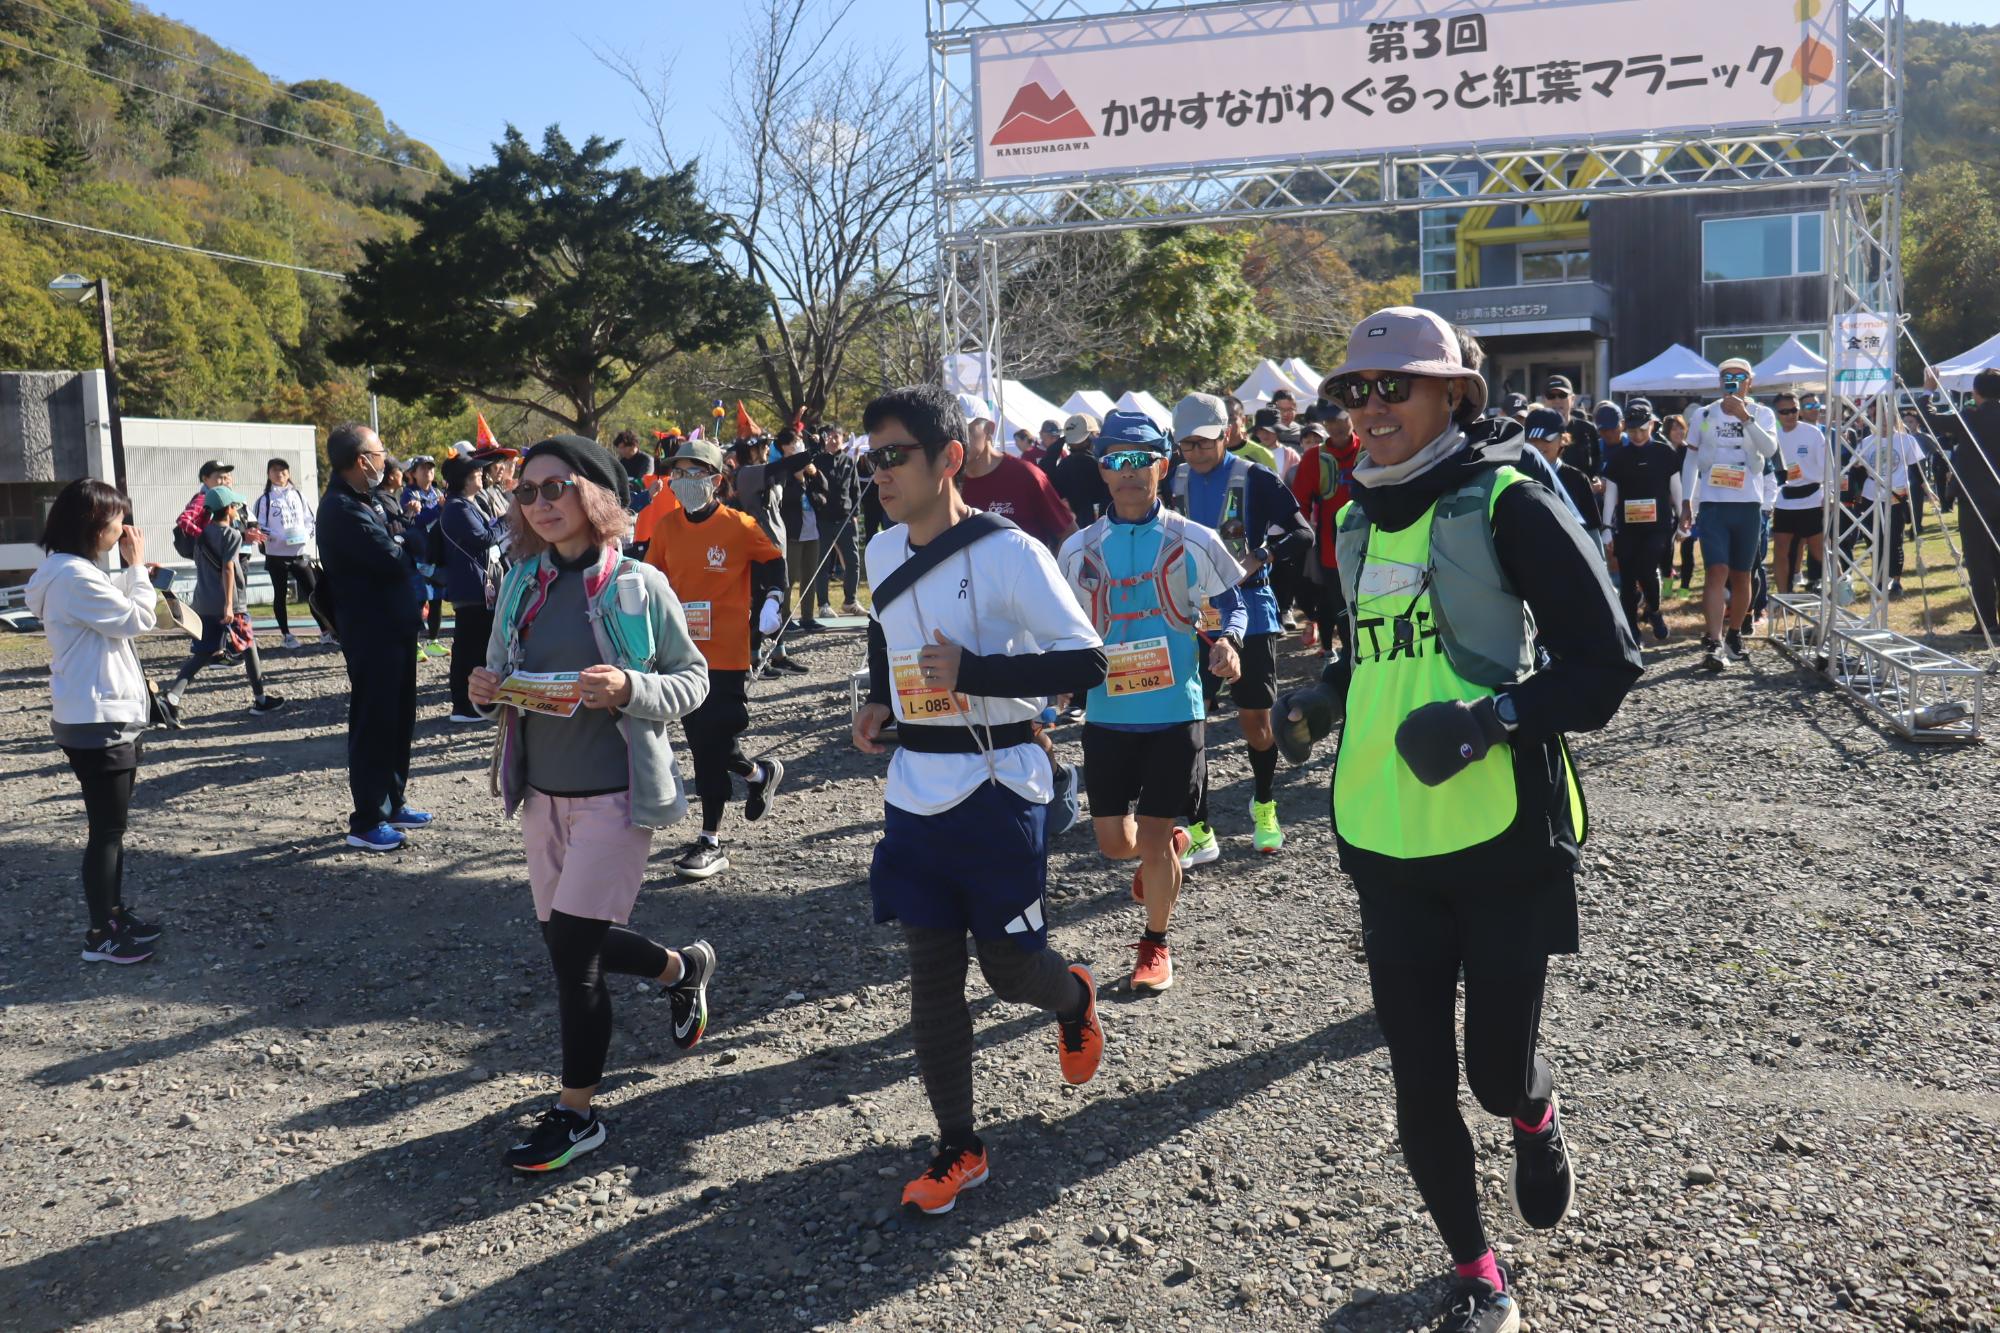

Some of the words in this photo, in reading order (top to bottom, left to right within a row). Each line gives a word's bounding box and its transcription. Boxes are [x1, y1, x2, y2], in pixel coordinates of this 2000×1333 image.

[1366, 12, 1489, 64] 第3回
[1101, 44, 1785, 138] かみすながわぐるっと紅葉マラニック
[996, 141, 1091, 158] KAMISUNAGAWA
[1128, 675, 1160, 690] L-062
[520, 698, 559, 713] L-084
[909, 697, 951, 715] L-085
